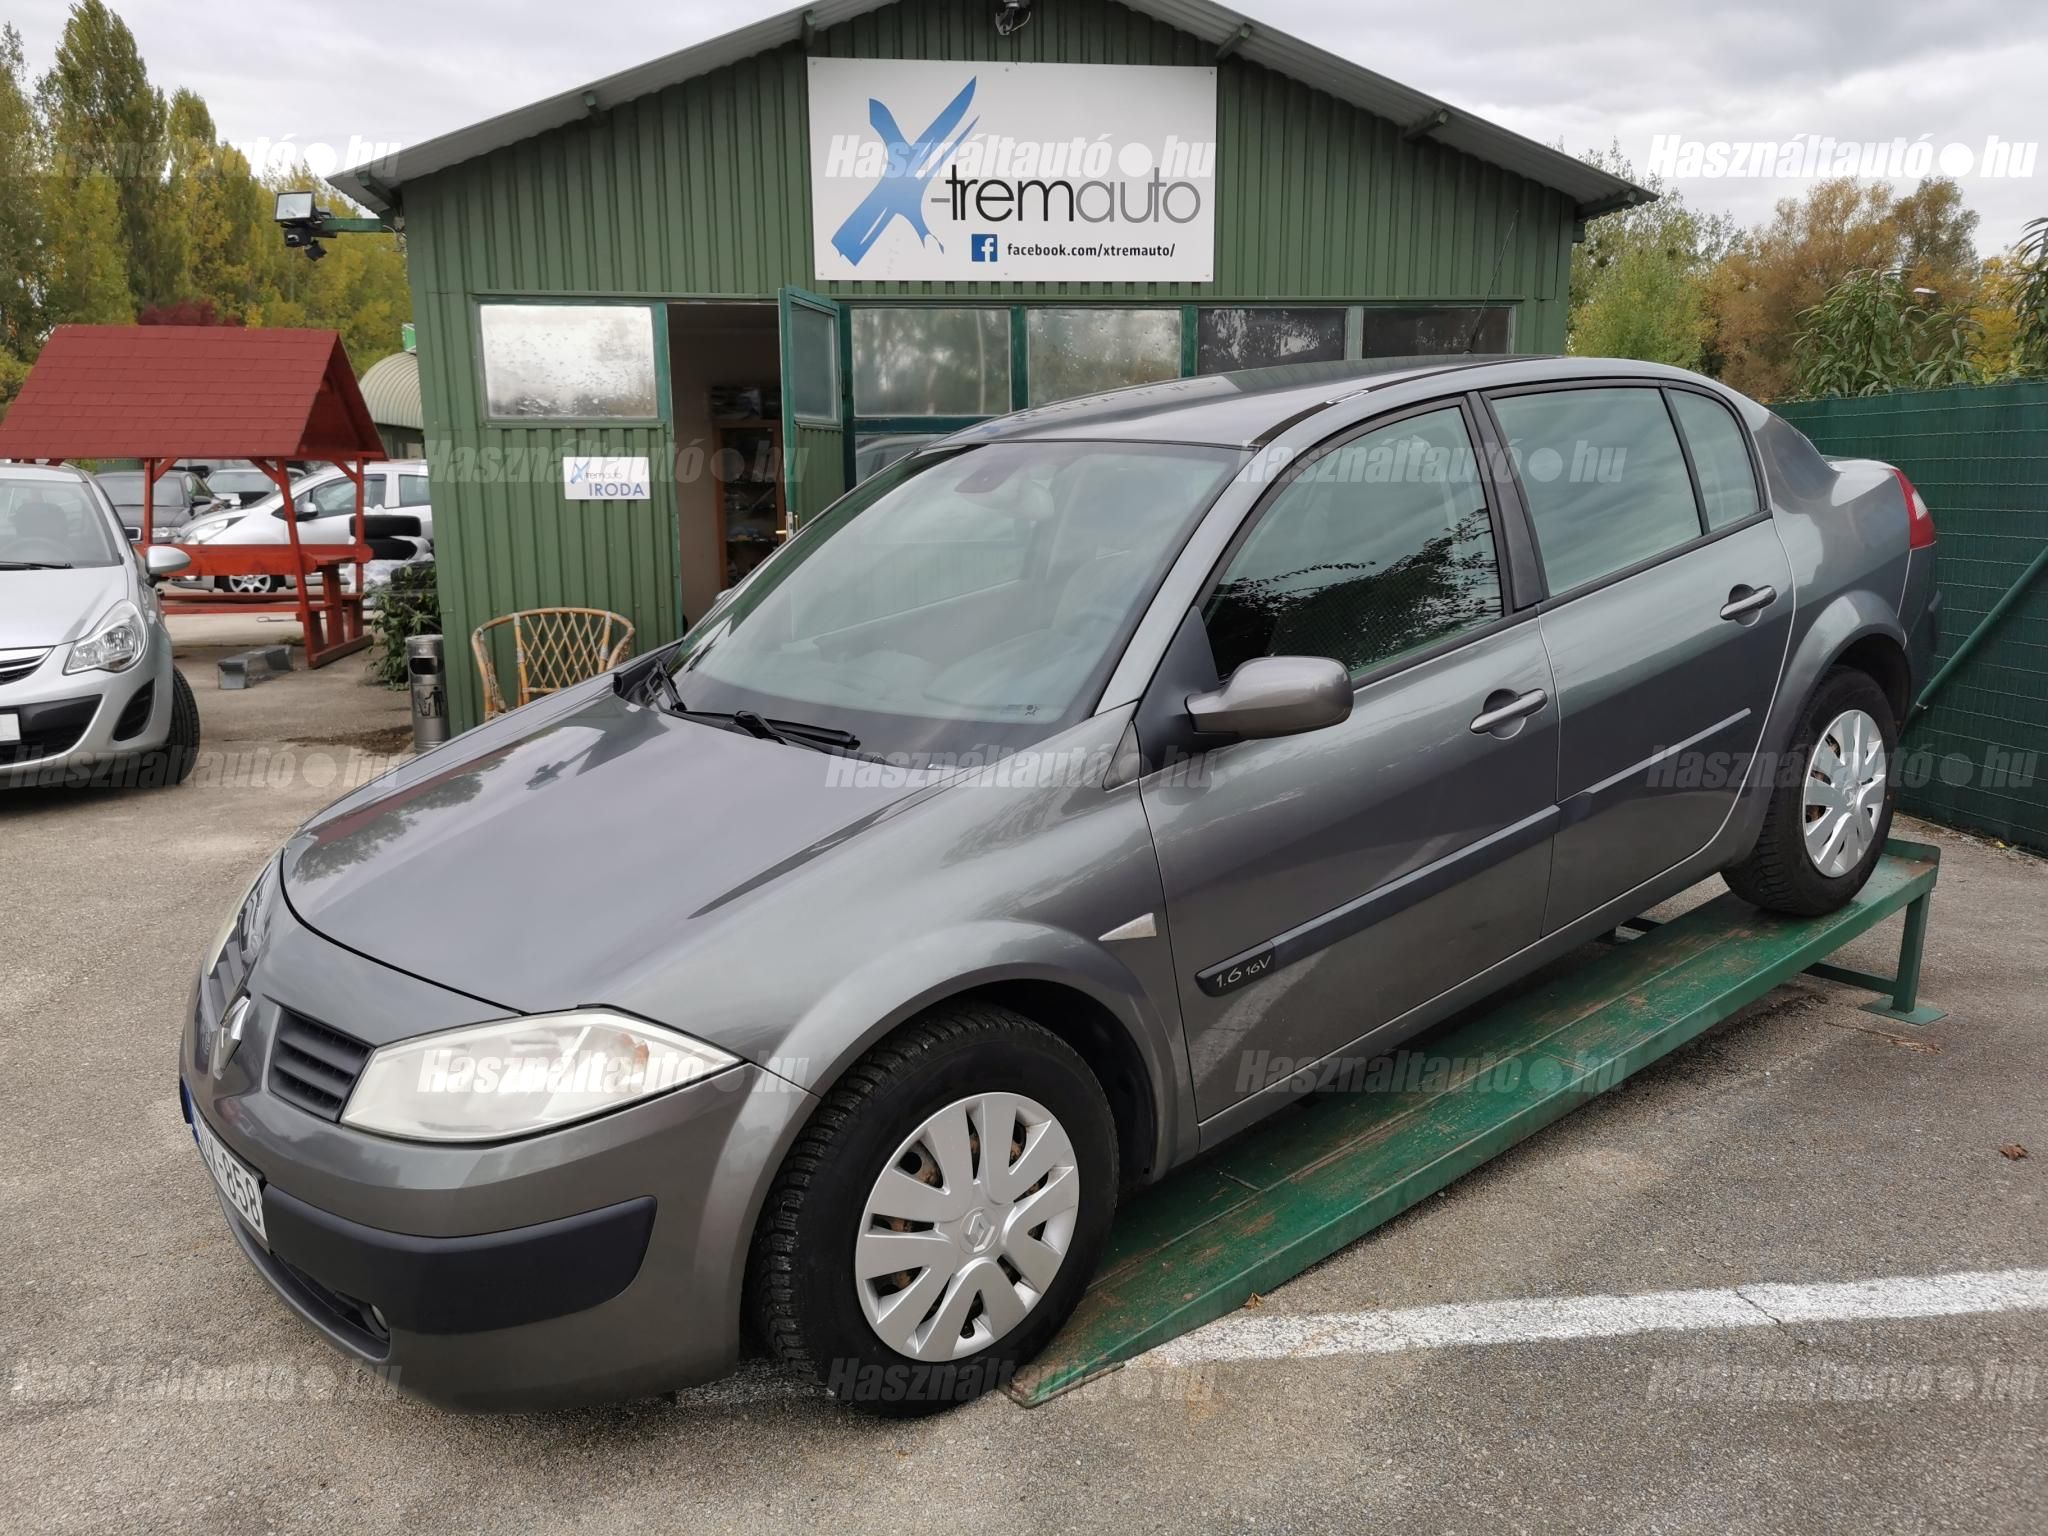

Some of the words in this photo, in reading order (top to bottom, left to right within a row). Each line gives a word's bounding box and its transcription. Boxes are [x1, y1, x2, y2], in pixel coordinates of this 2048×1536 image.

[1007, 242, 1176, 258] facebook.com/xtremauto/
[588, 482, 645, 497] IRODA
[1216, 967, 1242, 988] 1.6
[1245, 954, 1272, 976] 16V
